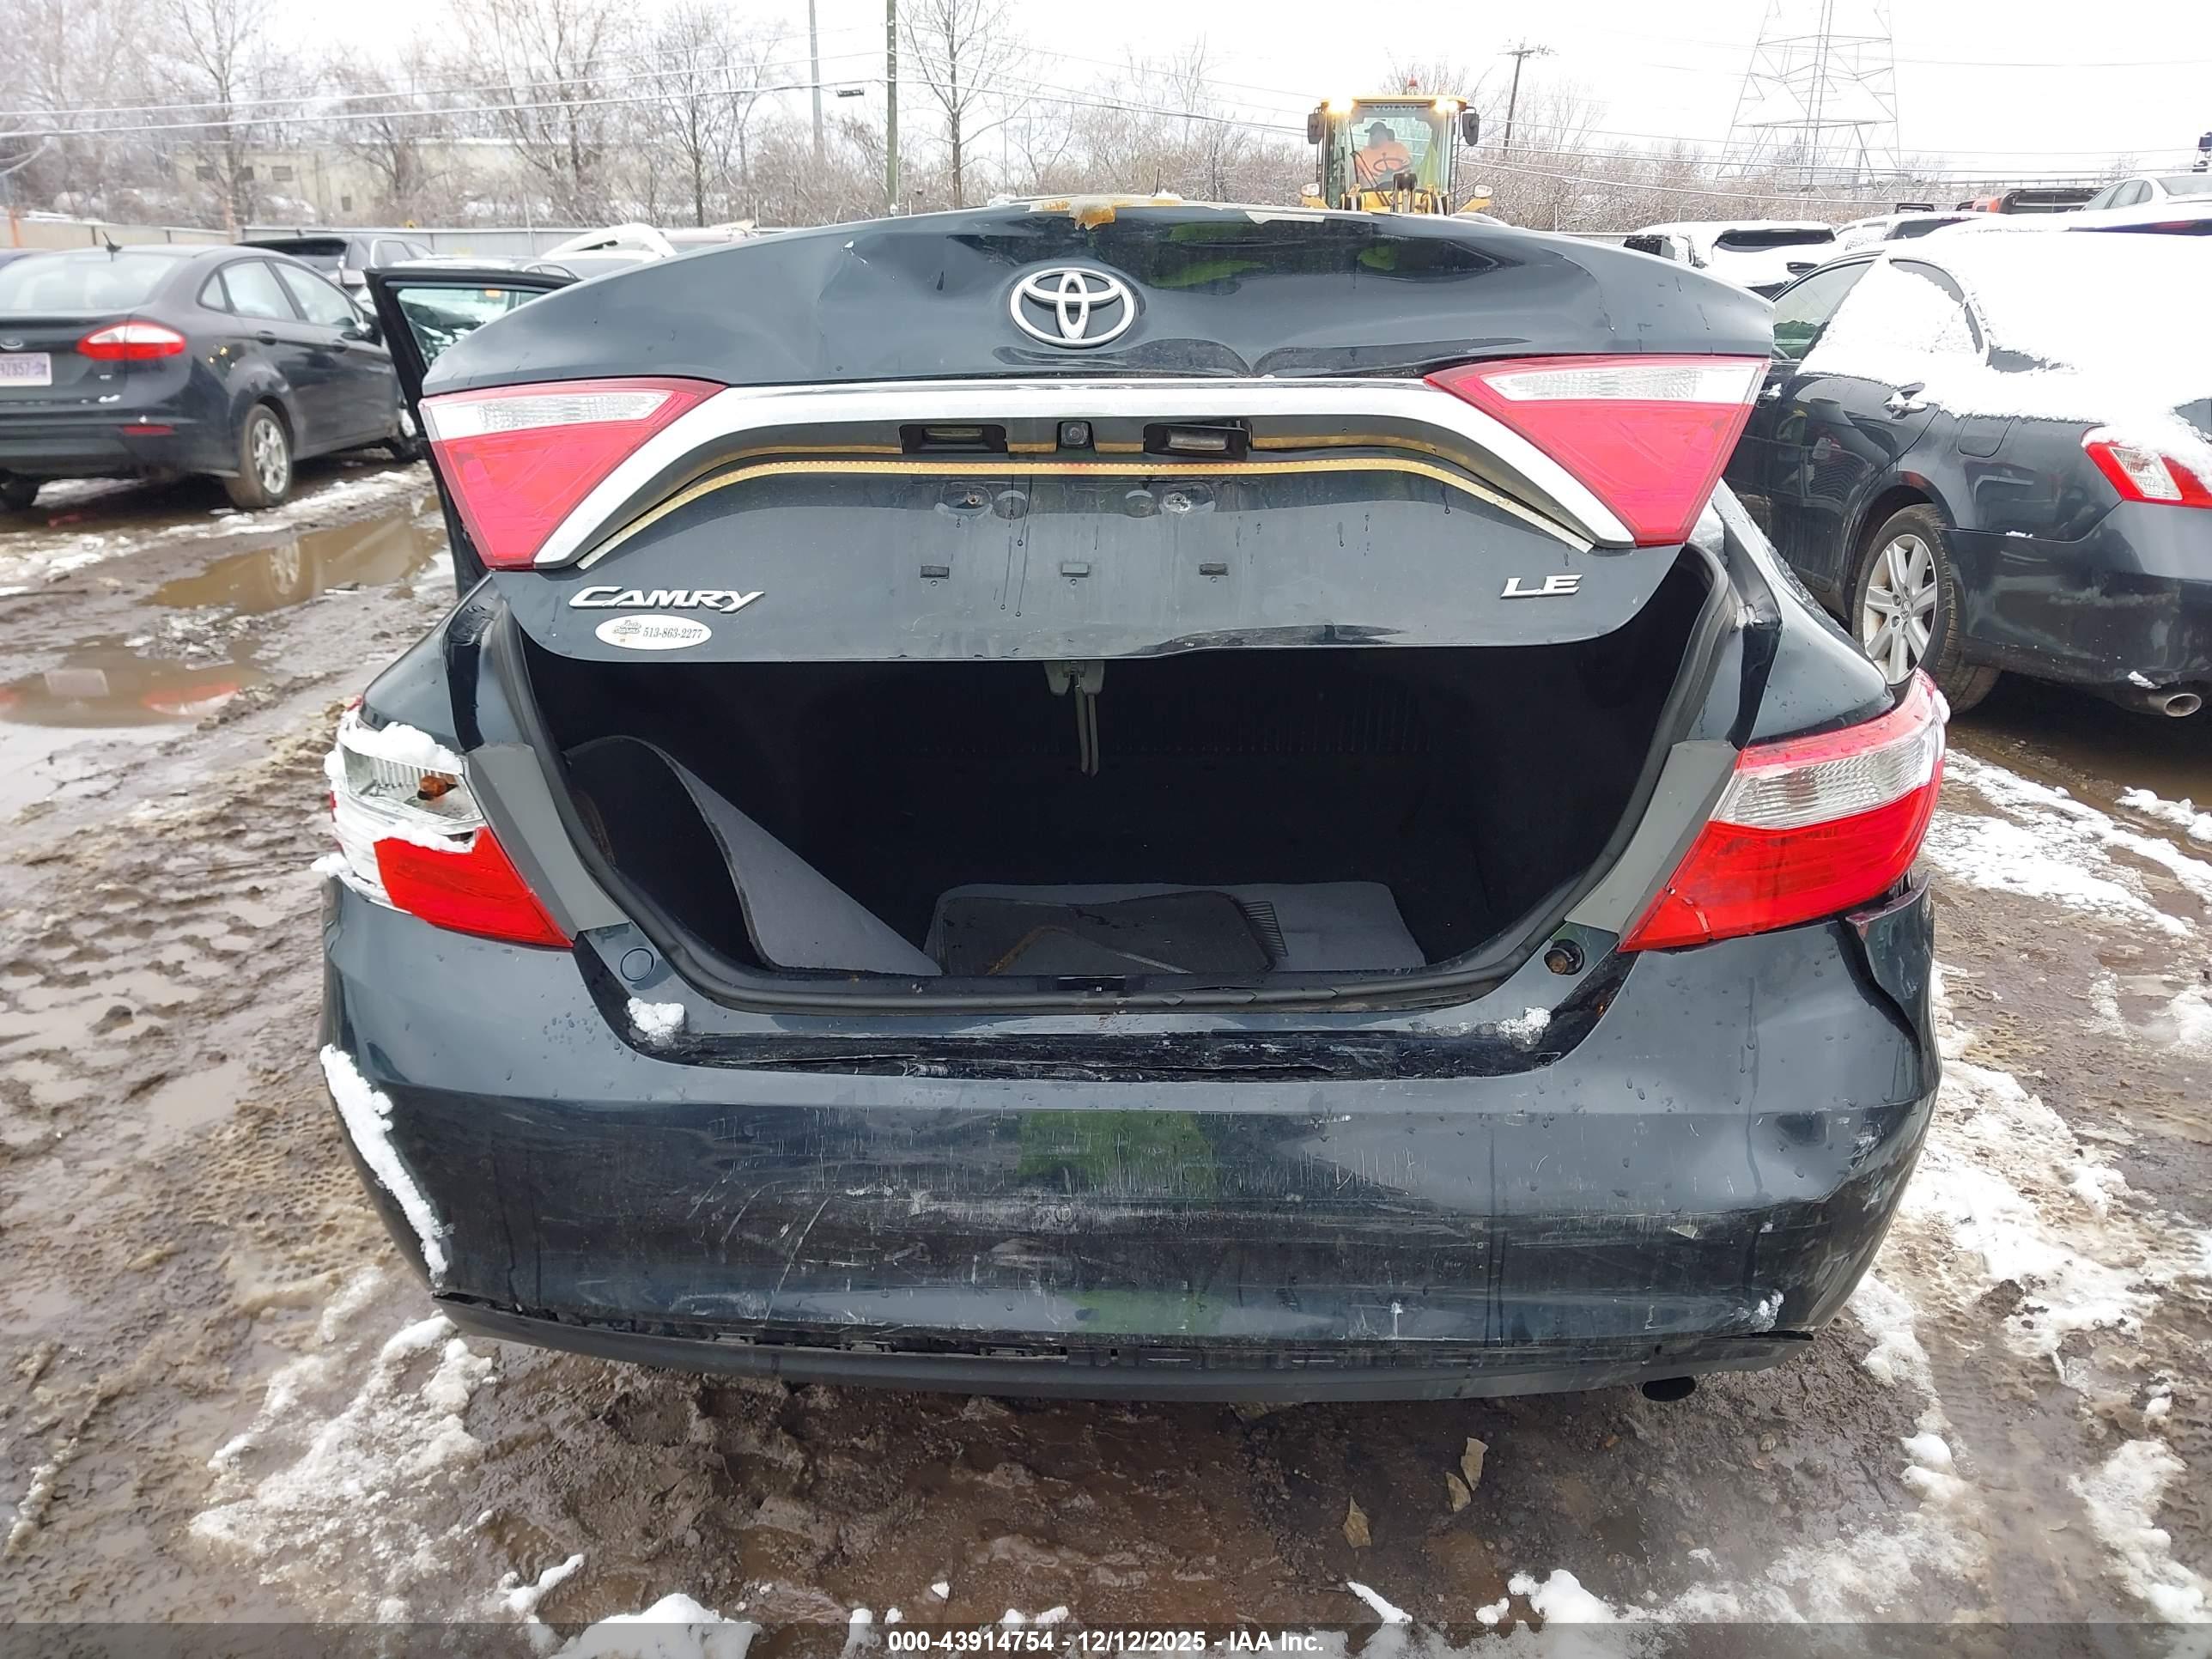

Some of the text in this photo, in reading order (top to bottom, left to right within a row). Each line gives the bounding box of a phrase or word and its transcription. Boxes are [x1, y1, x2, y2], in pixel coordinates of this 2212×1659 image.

[1500, 574, 1583, 599] LE
[568, 586, 765, 613] CAMRY
[642, 627, 703, 639] 513-863-2277
